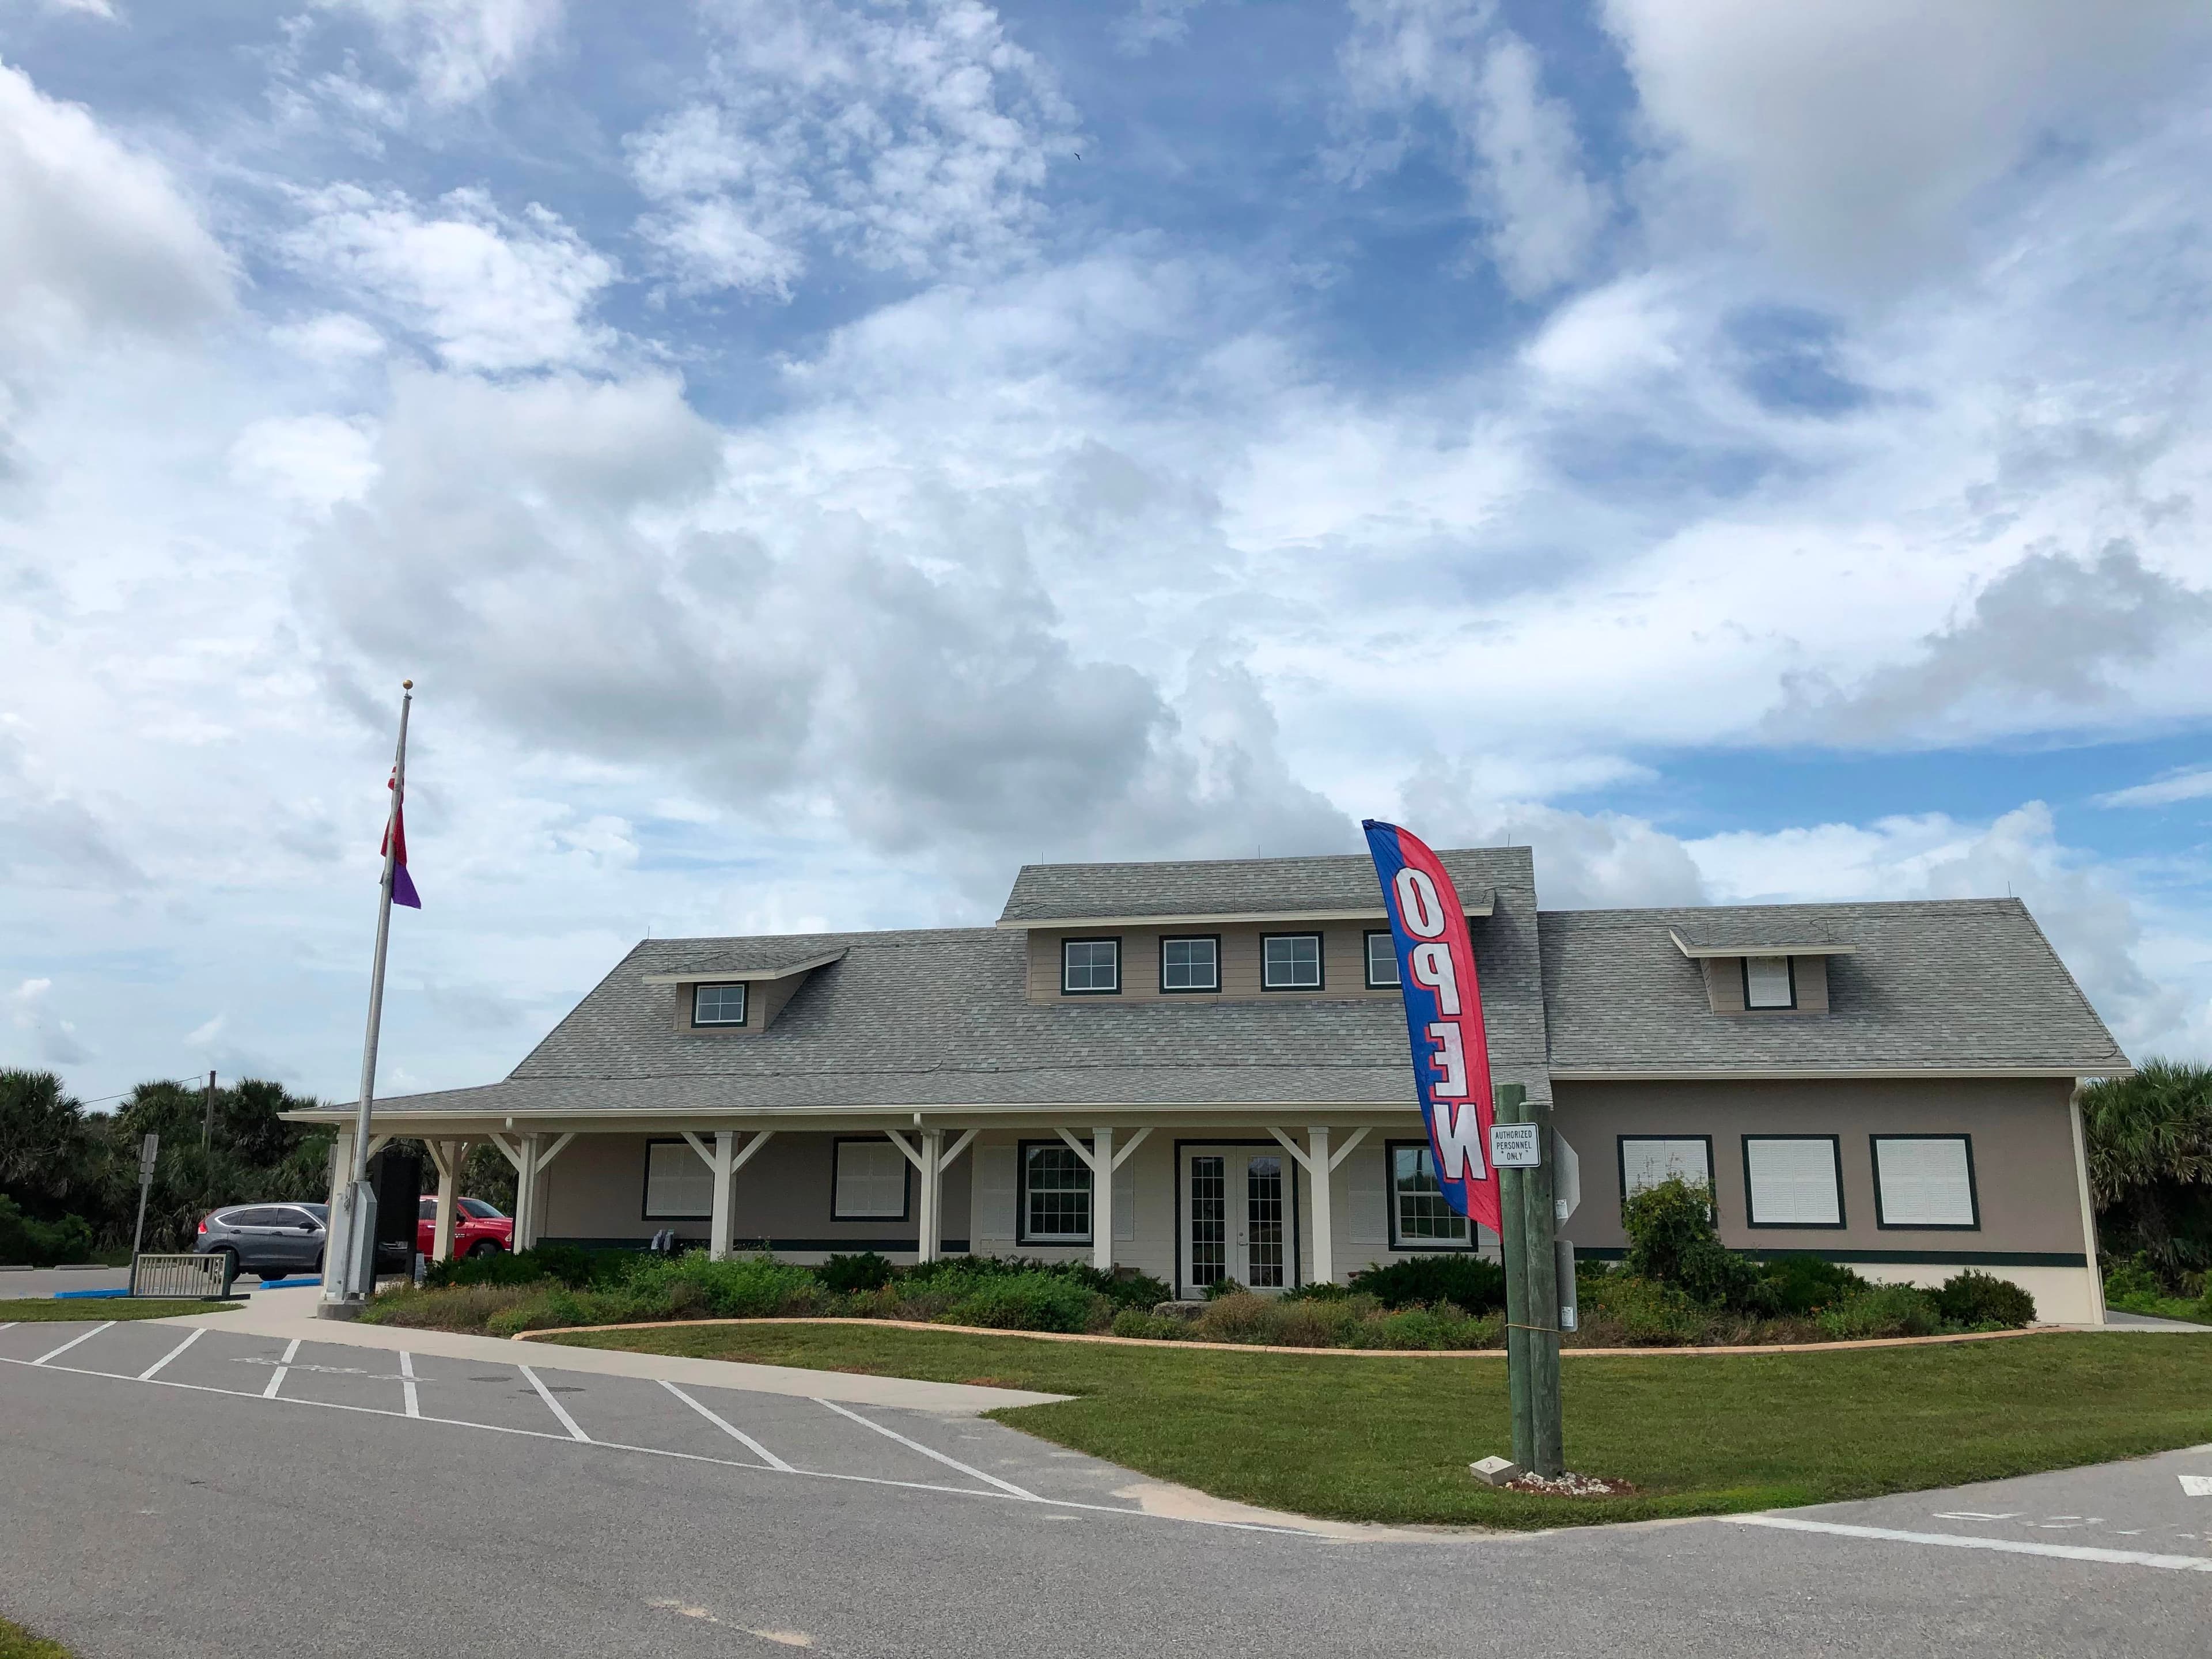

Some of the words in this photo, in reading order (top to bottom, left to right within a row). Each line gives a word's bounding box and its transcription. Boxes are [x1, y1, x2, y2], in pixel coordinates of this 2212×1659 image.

[1495, 1130, 1532, 1139] AUTHORIZED
[1497, 1141, 1532, 1150] PERSONNEL
[1507, 1152, 1522, 1161] ONLY
